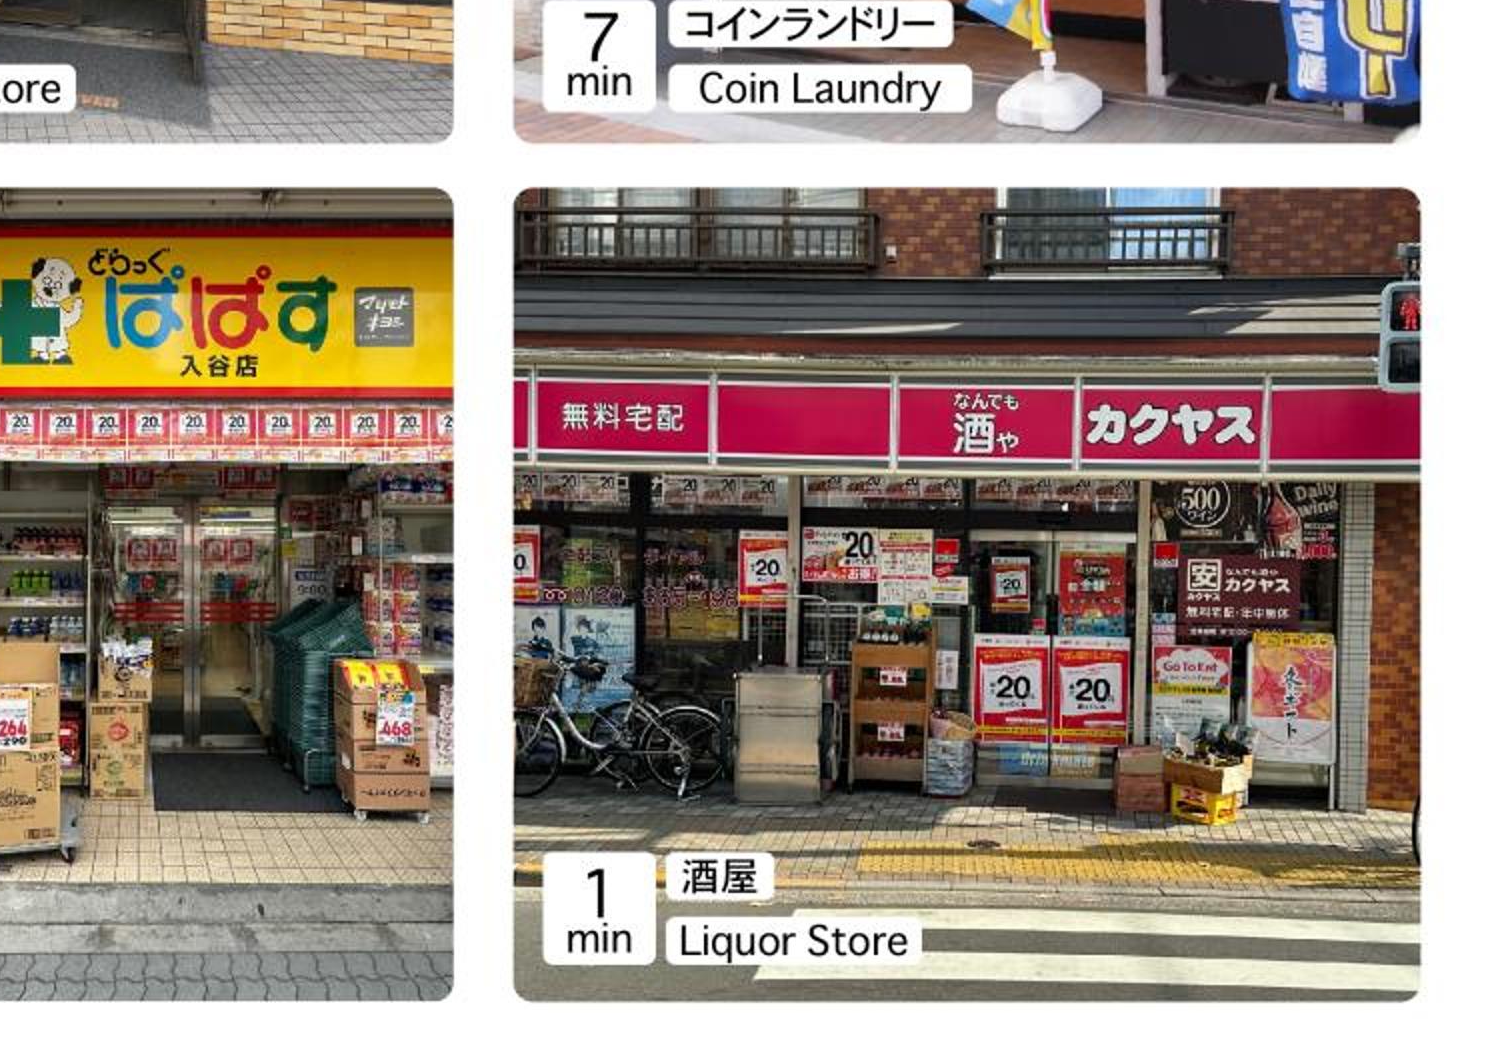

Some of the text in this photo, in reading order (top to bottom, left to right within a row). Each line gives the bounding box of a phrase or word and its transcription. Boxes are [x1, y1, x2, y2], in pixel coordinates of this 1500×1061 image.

[88, 247, 171, 277] どらっぐ
[104, 264, 338, 353] ぱぱす
[180, 355, 261, 378] 入谷店
[953, 392, 1019, 411] なんでも
[561, 402, 685, 433] 無料宅配
[1085, 403, 1257, 446] カクヤス
[953, 412, 1019, 455] 酒や
[1181, 487, 1222, 511] 500
[1225, 578, 1291, 593] カクヤス
[996, 674, 1032, 700] 20
[1074, 678, 1111, 704] 20
